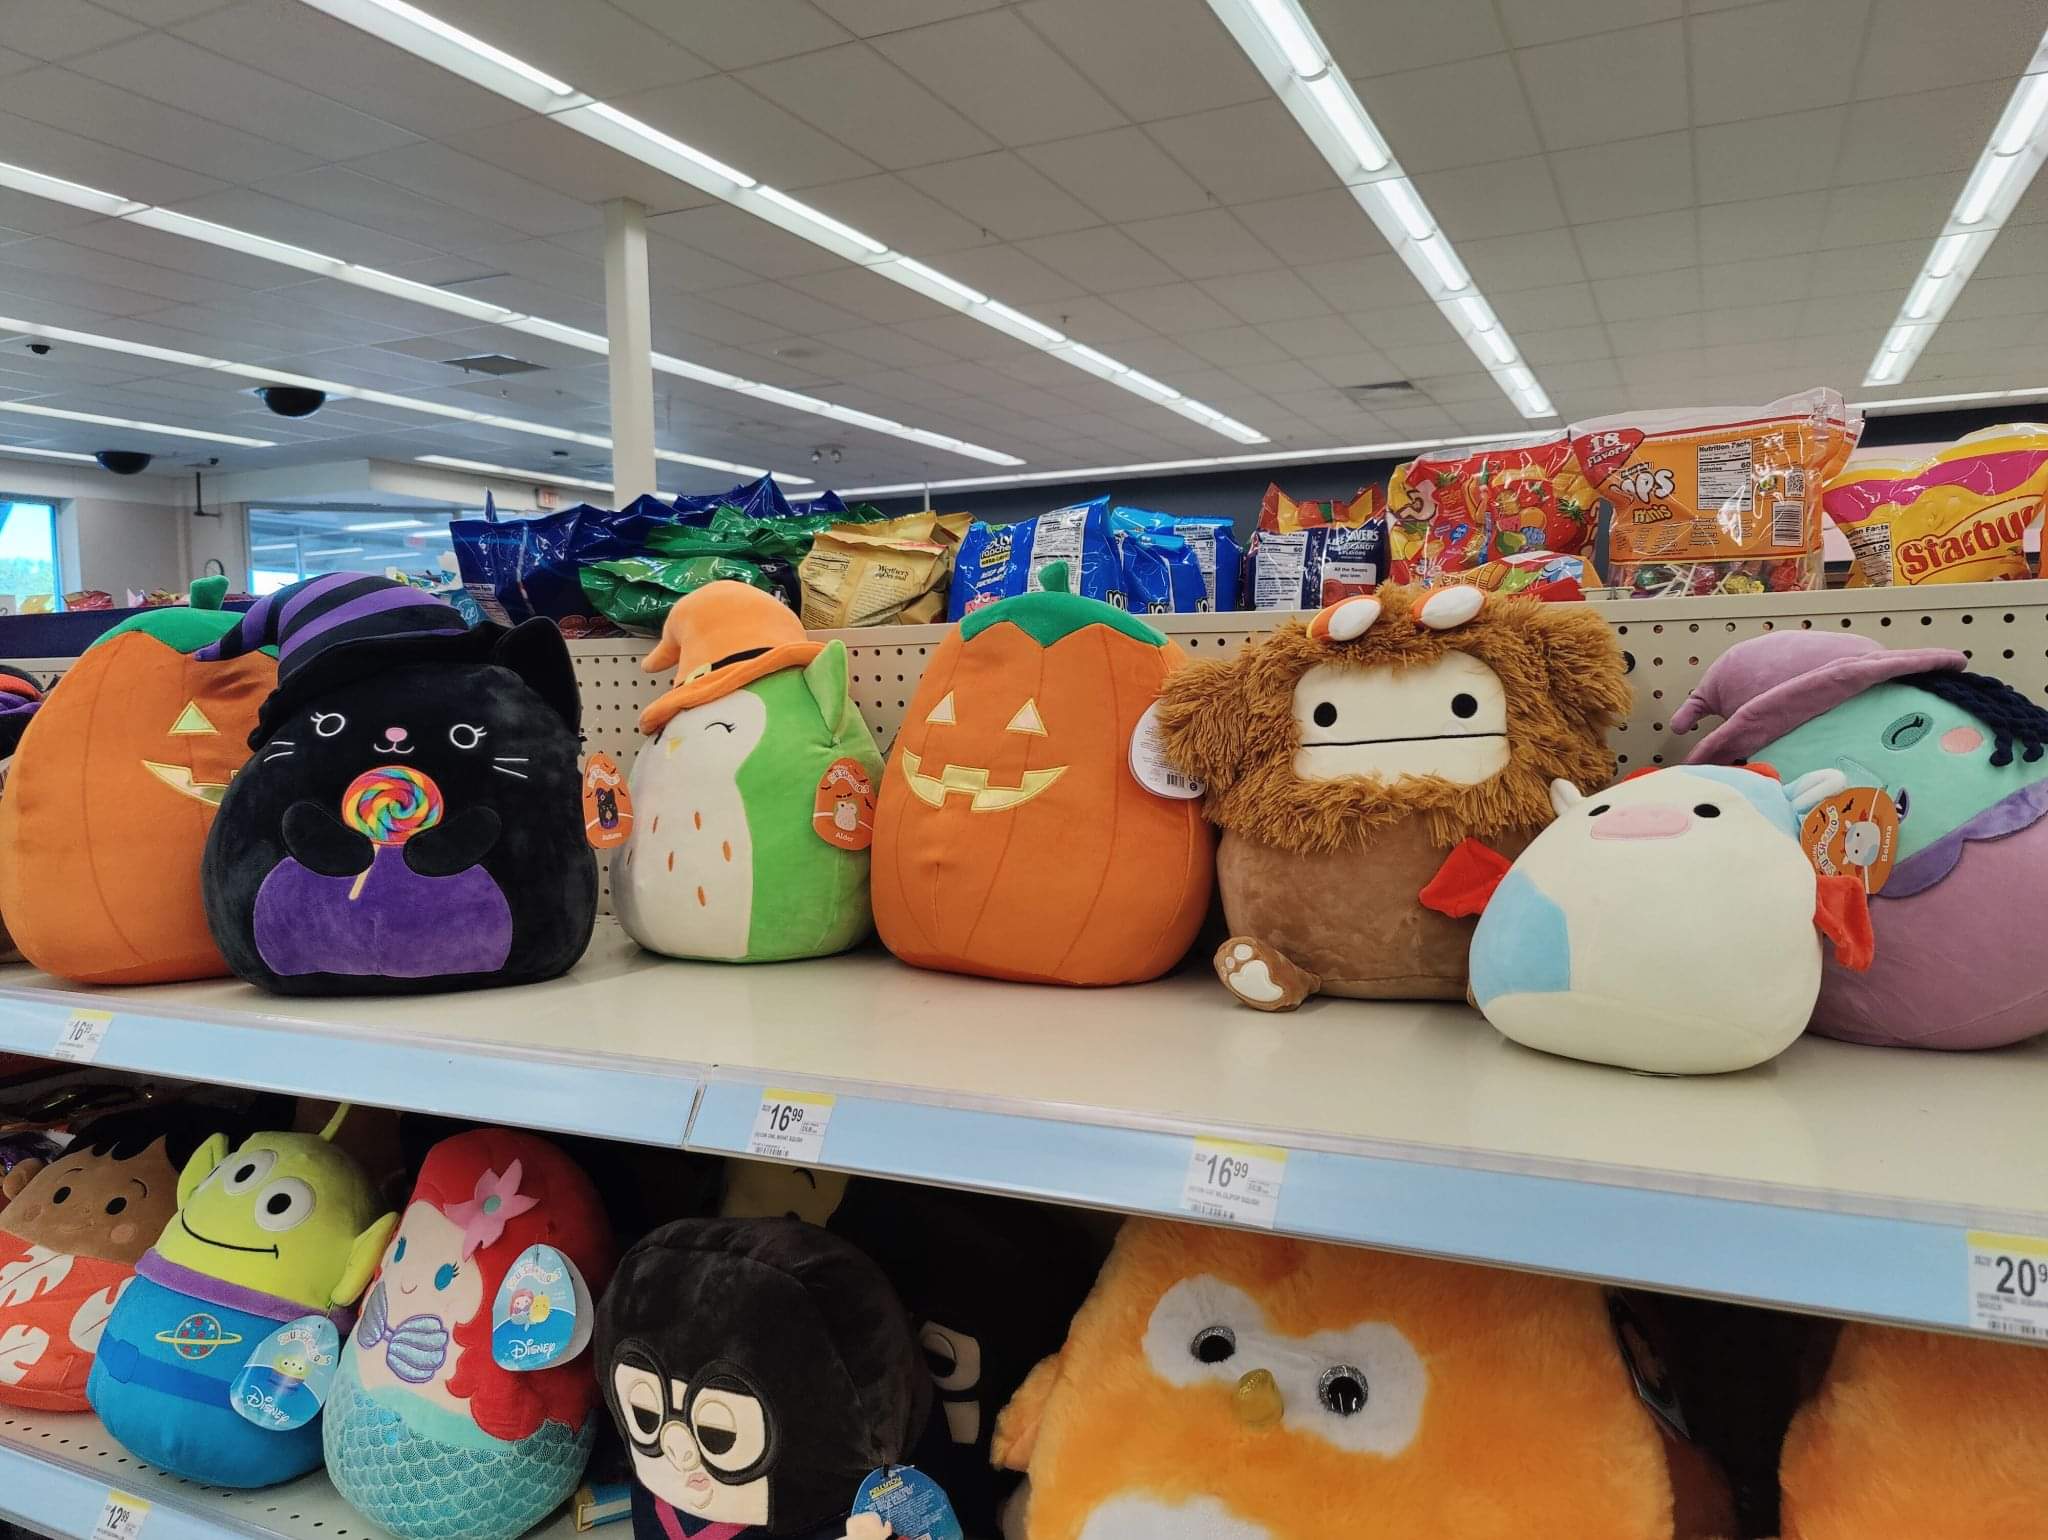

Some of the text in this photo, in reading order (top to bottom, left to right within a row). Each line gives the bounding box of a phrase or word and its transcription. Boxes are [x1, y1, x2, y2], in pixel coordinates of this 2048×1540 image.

[1591, 432, 1620, 454] 18
[508, 1338, 556, 1360] Disney
[246, 1385, 290, 1424] Disney
